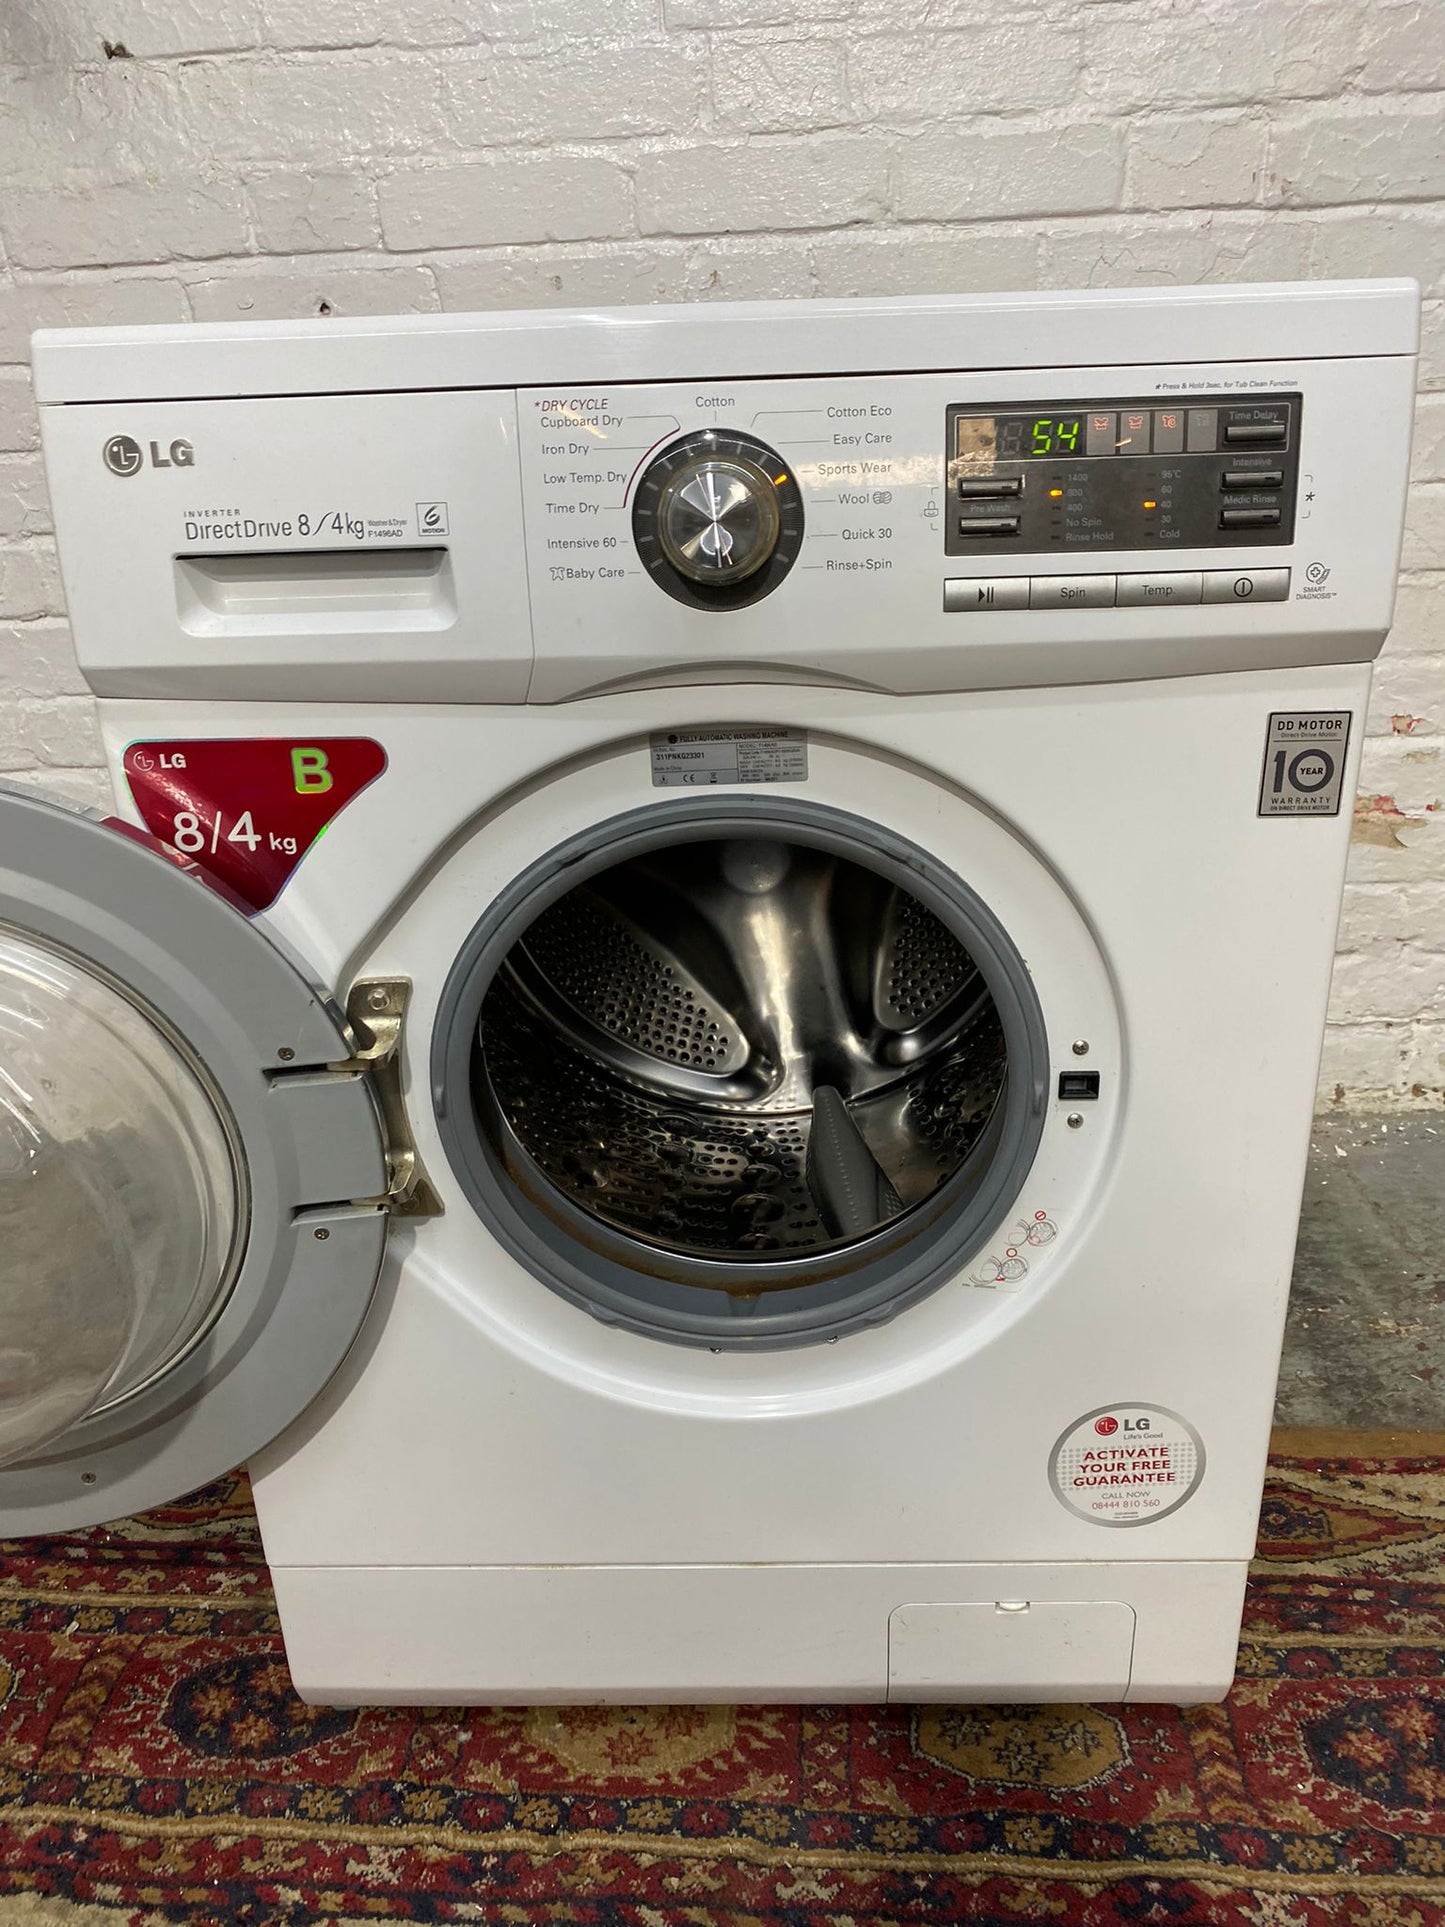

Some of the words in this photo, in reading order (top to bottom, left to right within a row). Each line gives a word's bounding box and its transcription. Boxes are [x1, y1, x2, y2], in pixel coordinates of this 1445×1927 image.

[570, 398, 608, 411] CYCLE
[696, 396, 735, 408] Cotton
[827, 406, 866, 418] Cotton
[870, 405, 892, 416] Eco
[1229, 410, 1250, 420] Time
[1253, 410, 1278, 421] Delay
[540, 415, 598, 428] Cupboard
[602, 414, 624, 428] Dry
[833, 434, 861, 446] Easy
[864, 433, 892, 444] Care
[1032, 420, 1080, 454] 54
[150, 438, 196, 468] LG
[542, 444, 566, 455] Iron
[568, 443, 590, 456] Dry
[1232, 458, 1272, 467] Intensive
[818, 464, 857, 476] Sports
[861, 463, 892, 473] Wear
[543, 473, 567, 484] Low
[569, 472, 605, 485] Temp.
[607, 471, 628, 484] Dry
[1068, 474, 1088, 483] 1400
[1161, 486, 1172, 494] 60
[838, 493, 870, 504] Wool
[1160, 500, 1172, 508] 40
[1224, 496, 1250, 505] Medic
[1252, 494, 1278, 504] Rinse
[183, 508, 241, 518] INVERTER
[546, 502, 576, 514] Time
[579, 502, 600, 514] Dry
[970, 504, 986, 513] Pre
[987, 504, 1011, 512] Wash
[1066, 518, 1079, 527] No
[1080, 518, 1102, 528] Spin
[1160, 515, 1172, 524] 30
[842, 529, 874, 541] Quick
[878, 528, 892, 539] 30
[1066, 533, 1090, 542] Rinse
[1092, 532, 1114, 541] Hold
[1160, 530, 1180, 539] Cold
[547, 538, 600, 549] Intensive
[602, 537, 616, 548] 60
[826, 559, 892, 571] Rinse+Spin
[566, 568, 595, 580] Baby
[598, 567, 625, 578] Care
[1060, 586, 1086, 600] Spin
[1142, 584, 1176, 598] Temp.
[1278, 720, 1294, 731] DD
[1298, 720, 1342, 730] MOTOR
[680, 736, 698, 744] FULLY
[700, 734, 732, 742] AUTOMATIC
[734, 732, 761, 741] WASHING
[762, 731, 788, 739] MACHINE
[160, 754, 186, 768] LG
[290, 747, 334, 794] B
[1273, 748, 1334, 793] 10
[1300, 768, 1324, 776] YEAR
[1271, 796, 1331, 805] WARRANTY
[173, 810, 262, 854] 8/4
[269, 832, 297, 855] kg
[1124, 1418, 1150, 1432] LG
[1084, 1447, 1170, 1462] ACTIVATE
[1080, 1462, 1126, 1474] YOUR
[1132, 1460, 1172, 1471] FREE
[1073, 1472, 1176, 1487] GUARANTEE
[1102, 1492, 1124, 1500] CALL
[1126, 1490, 1152, 1498] NOW
[1092, 1501, 1120, 1510] 08444
[1122, 1500, 1140, 1508] 810
[1143, 1498, 1160, 1508] 560
